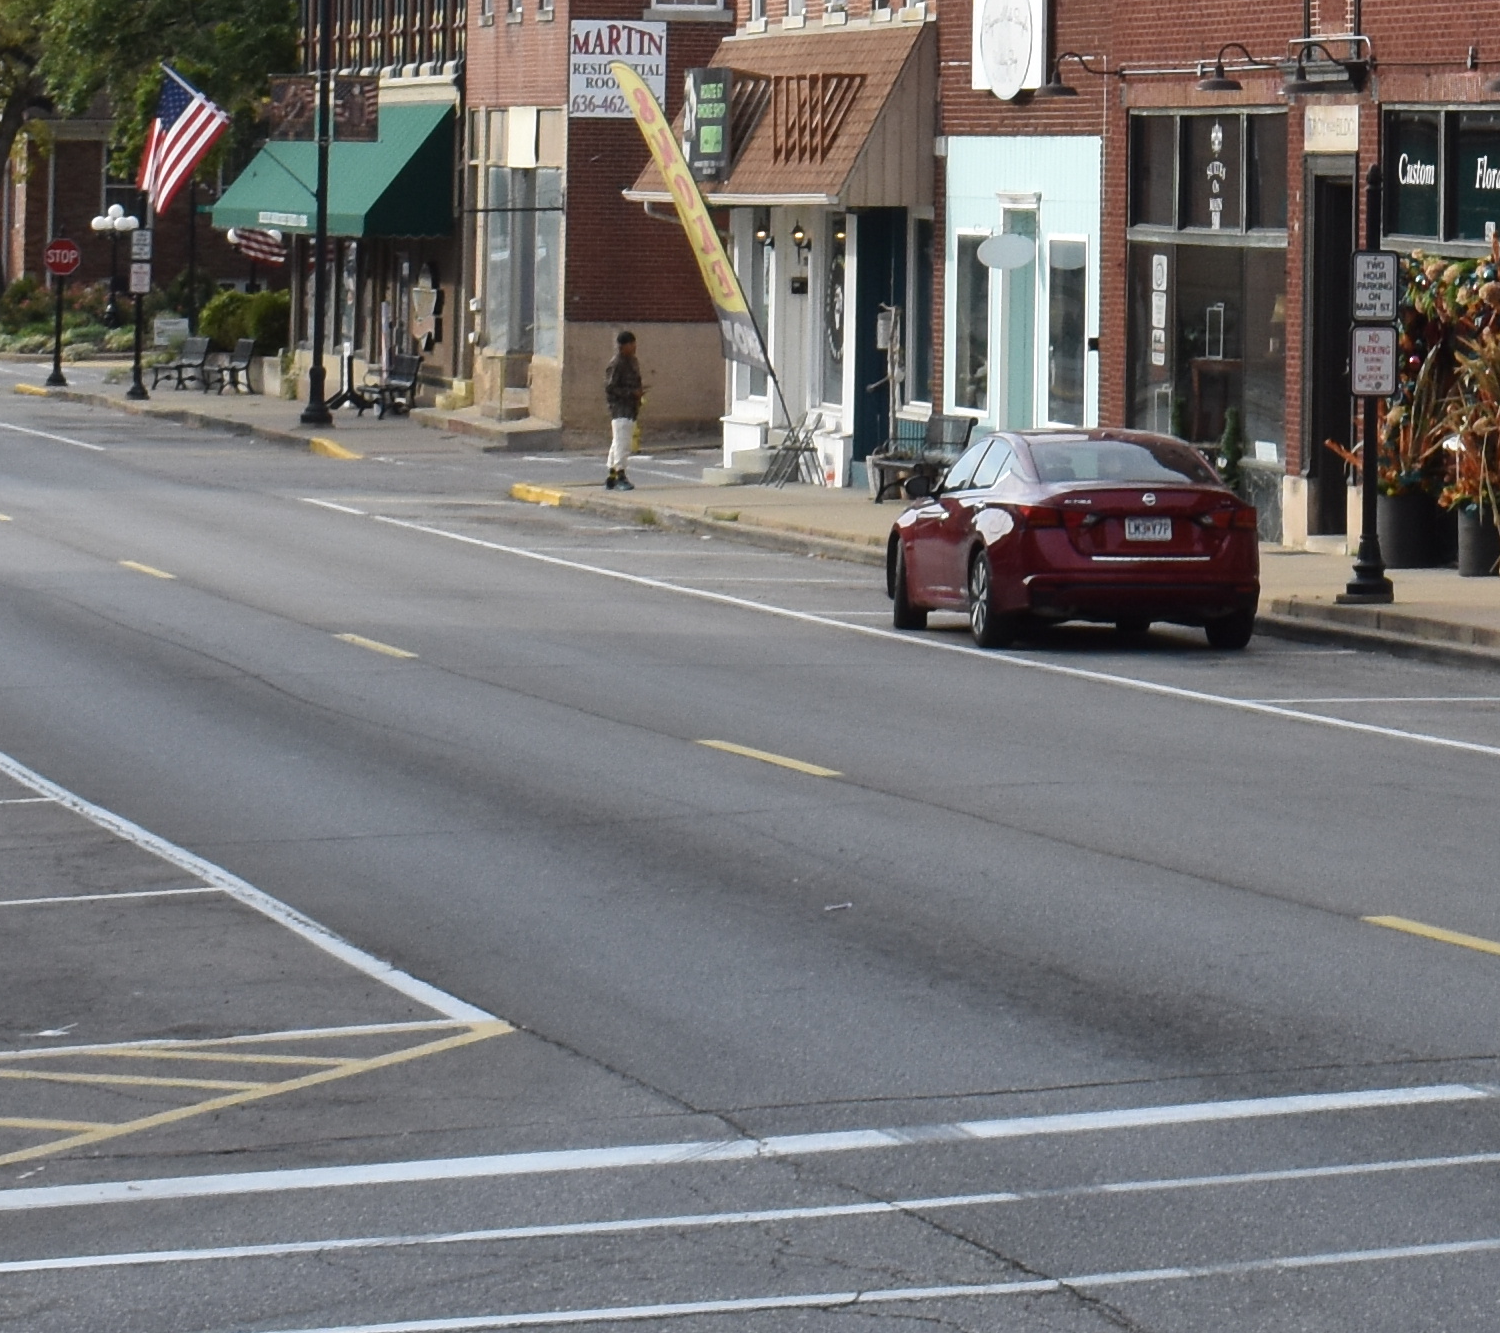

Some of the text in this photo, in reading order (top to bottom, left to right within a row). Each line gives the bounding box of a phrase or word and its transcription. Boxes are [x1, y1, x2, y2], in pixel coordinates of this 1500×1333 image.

[571, 23, 664, 56] MARTIN
[572, 62, 664, 77] RESIDTIAL
[1398, 152, 1435, 186] Custom
[47, 249, 78, 264] STOP
[1366, 260, 1385, 270] TWO
[1363, 272, 1387, 280] HOUR
[1357, 282, 1393, 291] PARKING
[1368, 293, 1381, 301] ON
[1356, 302, 1377, 311] MAIN
[1368, 334, 1380, 343] NO
[1357, 345, 1391, 354] PARKING
